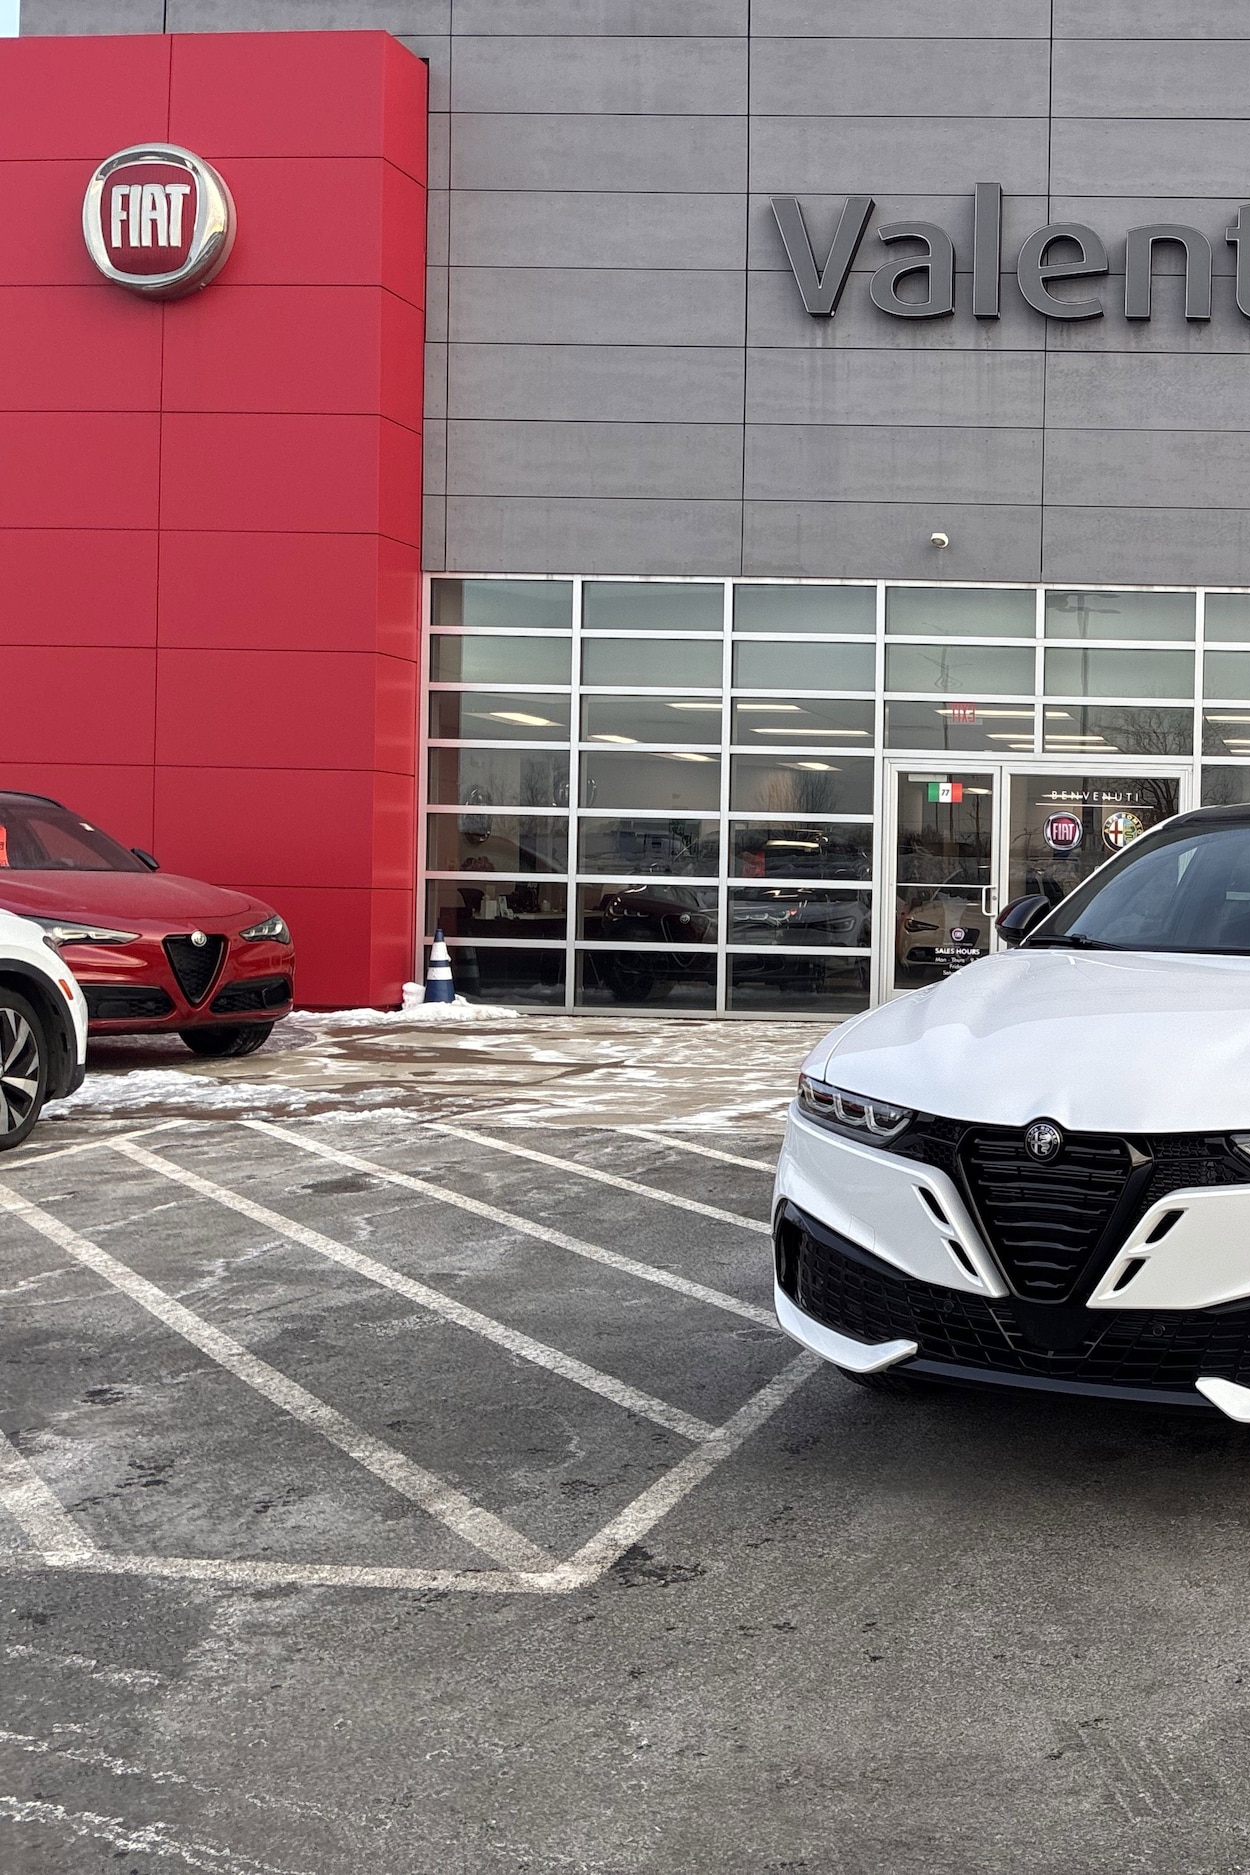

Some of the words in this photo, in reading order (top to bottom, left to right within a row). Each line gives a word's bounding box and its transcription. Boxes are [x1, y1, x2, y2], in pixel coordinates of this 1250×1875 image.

[111, 184, 191, 248] FIAT
[941, 789, 950, 797] 77
[1051, 790, 1139, 802] BENVENUTI
[1053, 823, 1074, 841] FIAT
